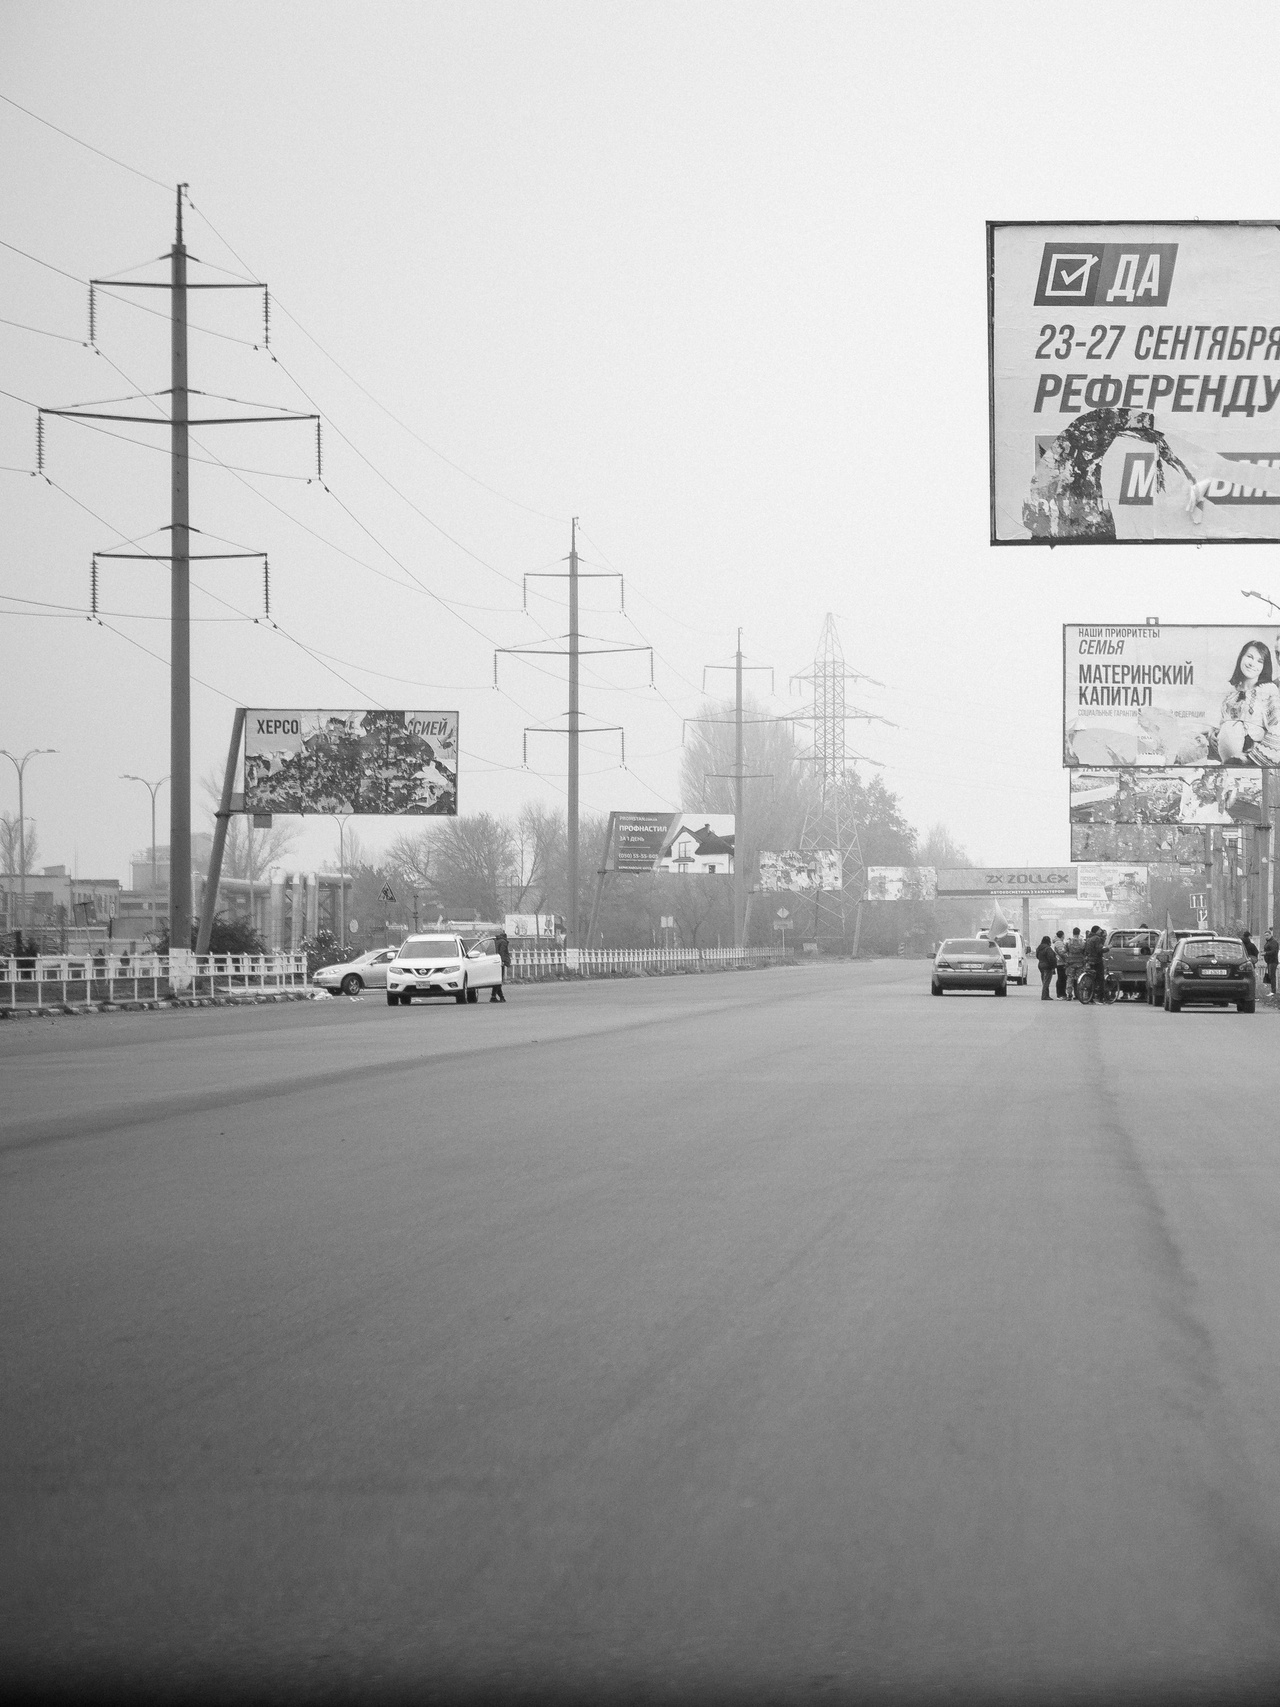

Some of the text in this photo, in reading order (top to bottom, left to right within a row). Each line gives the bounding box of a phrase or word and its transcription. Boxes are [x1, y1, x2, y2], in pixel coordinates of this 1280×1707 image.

[1106, 254, 1161, 302] ДА
[1034, 324, 1126, 360] 23-27
[1078, 628, 1160, 639] НАШИ ПРИОРИТЕТЫ
[1078, 640, 1125, 655] СЕМЬЯ
[1079, 660, 1194, 685] МАТЕРИНСКИЙ
[1078, 686, 1152, 707] КАПИТАЛ
[256, 719, 299, 735] ХЕРСО
[1007, 874, 1069, 884] ZOLLEX
